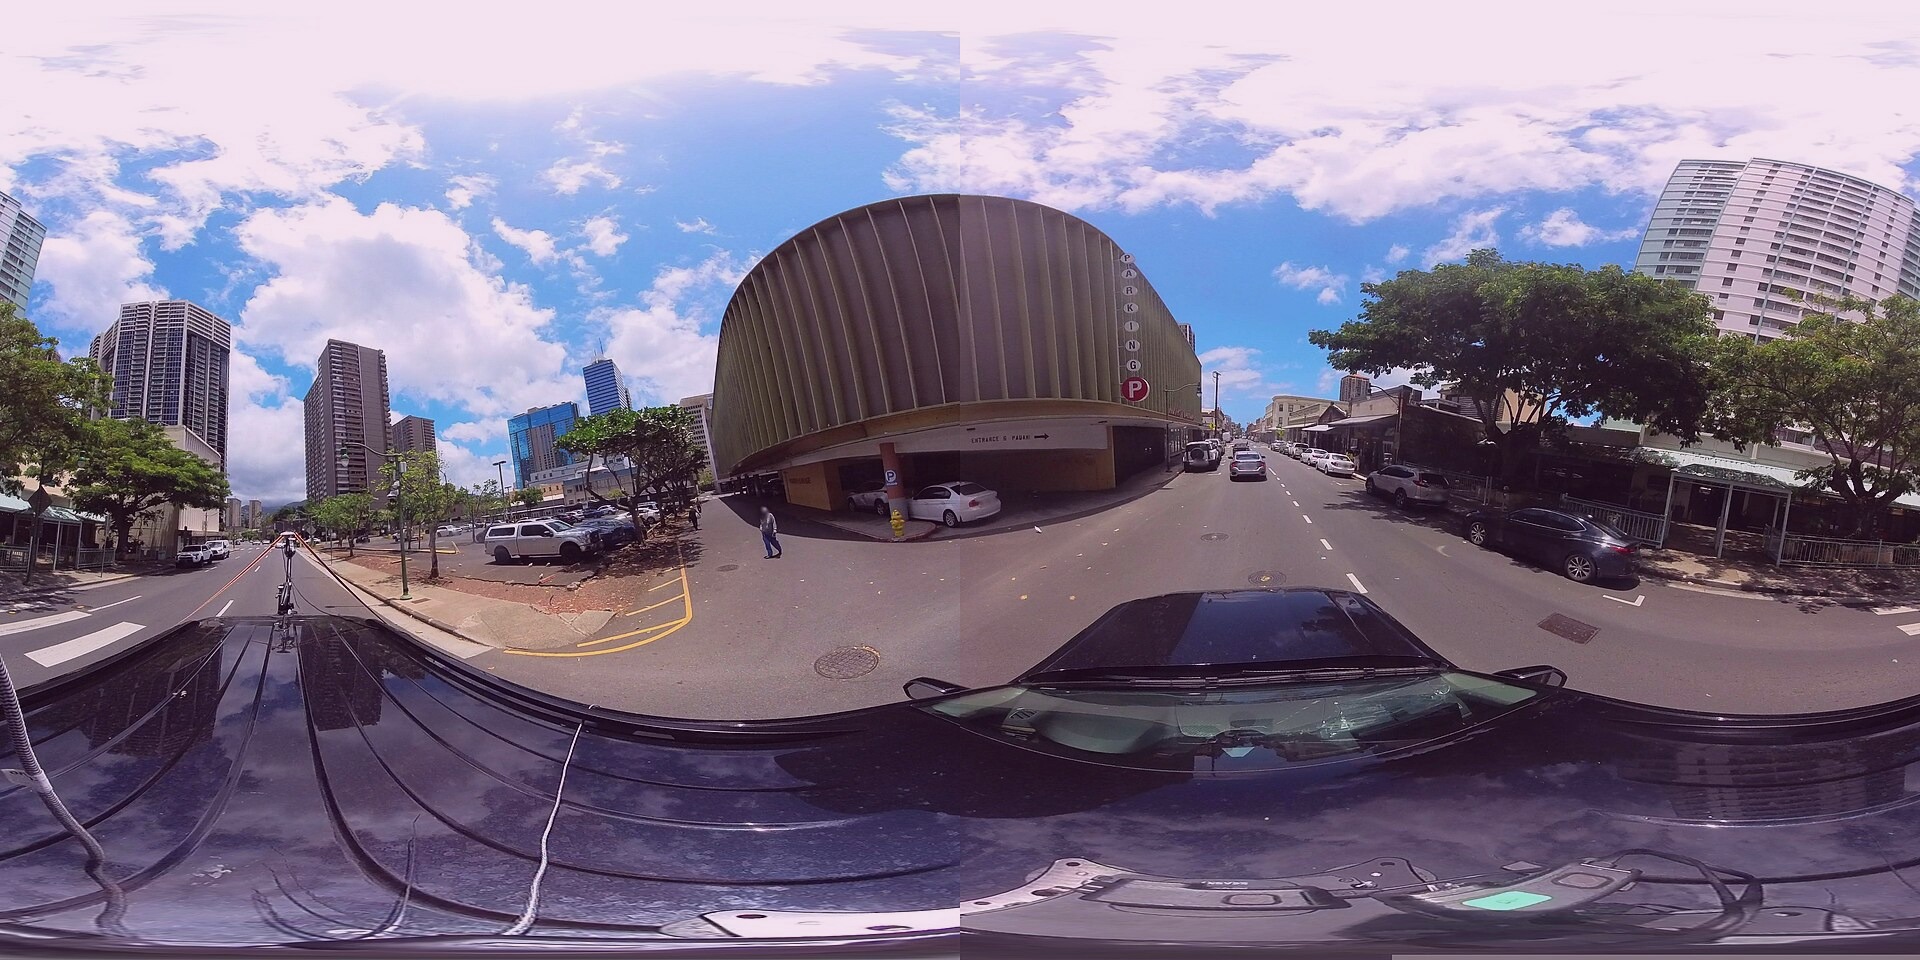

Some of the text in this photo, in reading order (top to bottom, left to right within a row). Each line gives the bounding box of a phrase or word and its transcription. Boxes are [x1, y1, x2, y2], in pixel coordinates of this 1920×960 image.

[1124, 255, 1137, 370] PARKING
[1128, 380, 1143, 399] P
[971, 436, 999, 444] ENTRANCE
